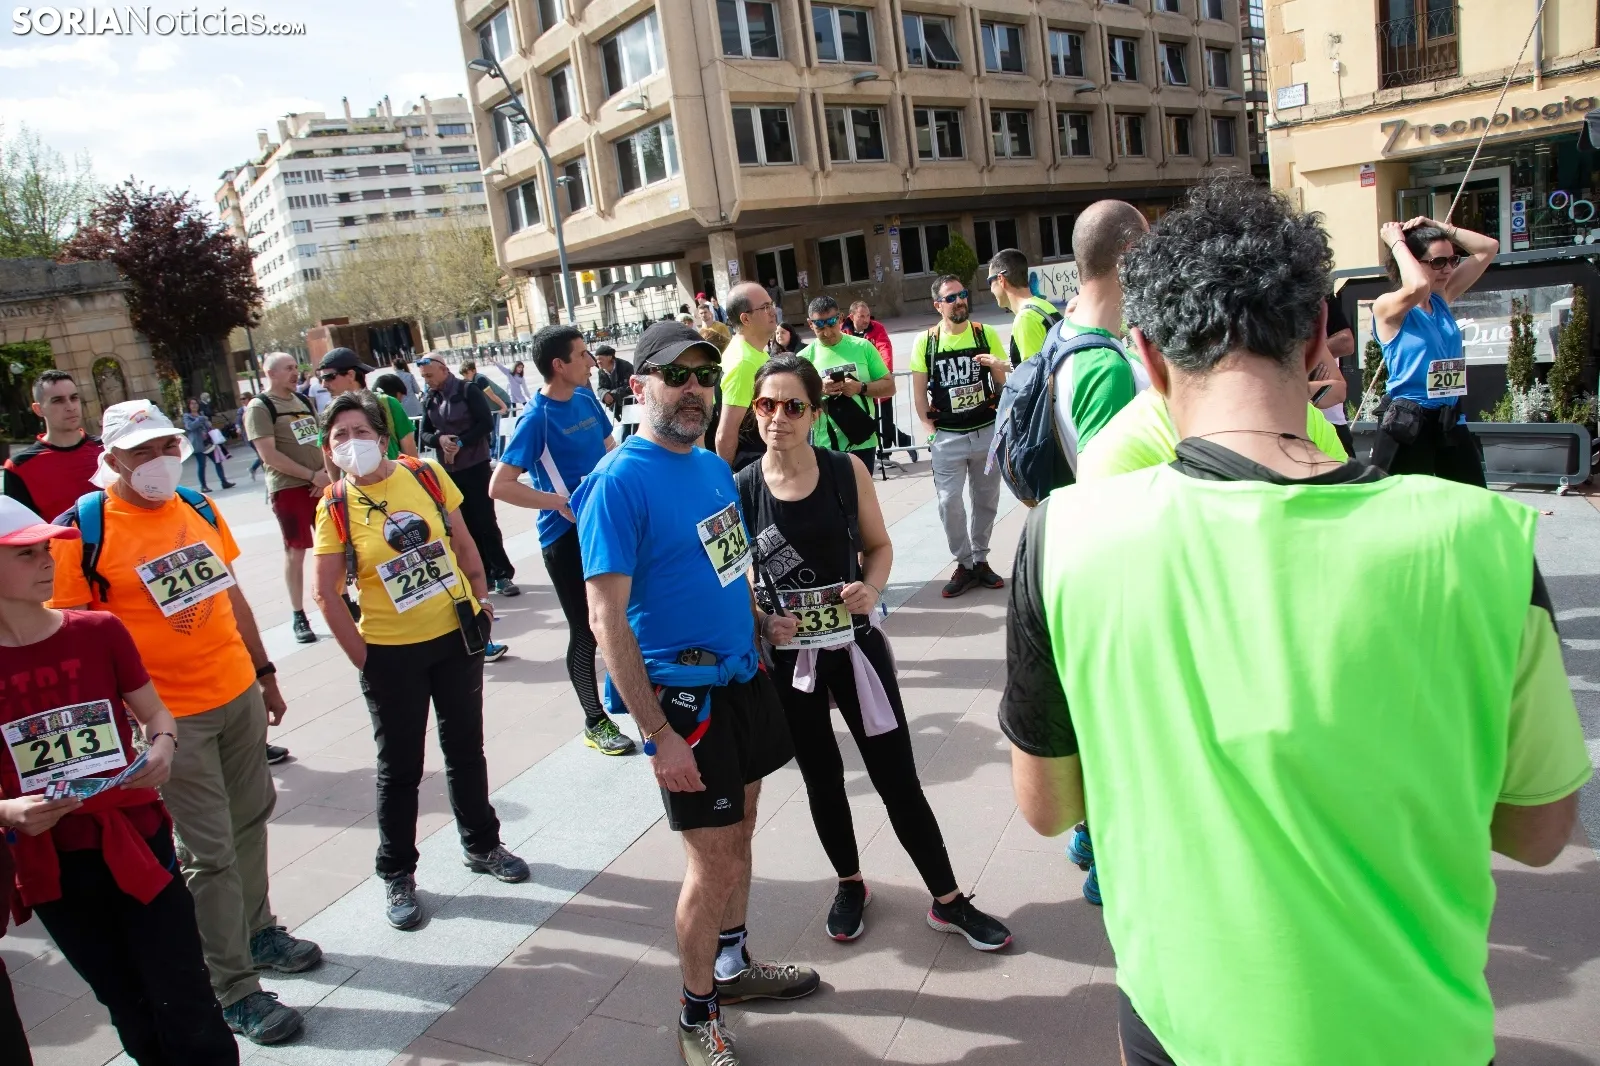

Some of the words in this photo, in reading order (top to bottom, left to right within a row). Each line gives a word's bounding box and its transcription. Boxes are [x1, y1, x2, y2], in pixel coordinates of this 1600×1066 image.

[936, 356, 971, 382] TAD
[1433, 373, 1460, 387] 207
[957, 393, 980, 408] 221
[717, 526, 746, 564] 234
[161, 561, 214, 597] 216
[396, 561, 441, 595] 226
[30, 728, 101, 769] 213
